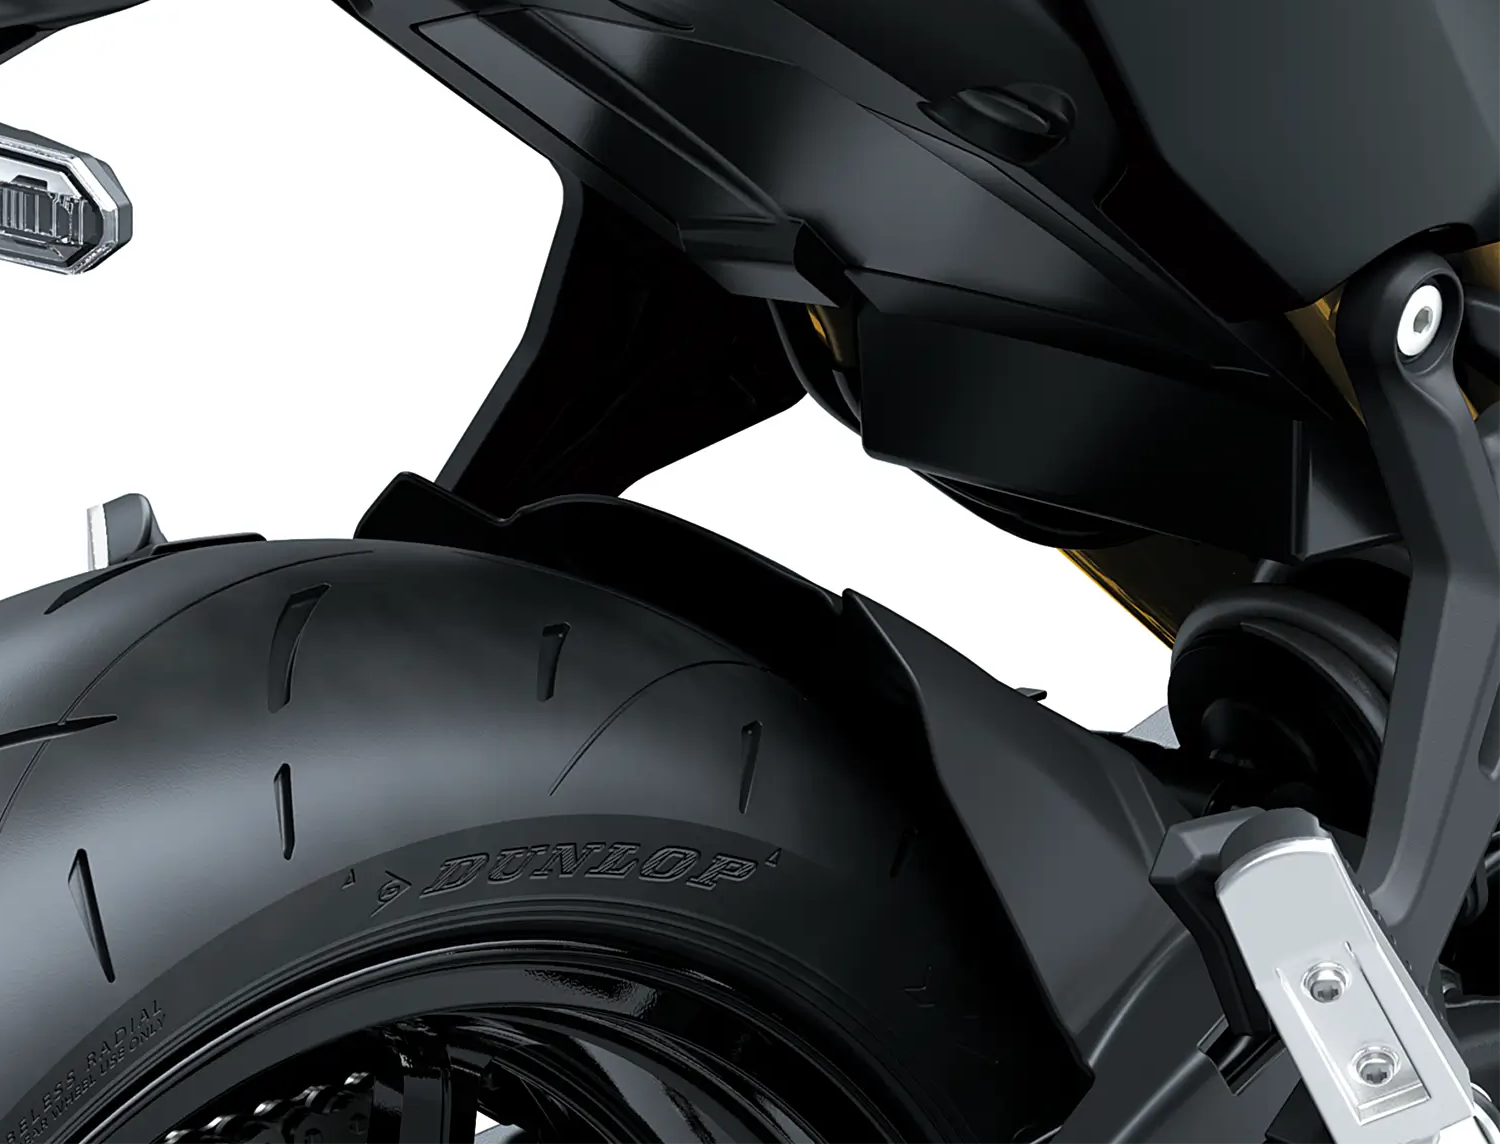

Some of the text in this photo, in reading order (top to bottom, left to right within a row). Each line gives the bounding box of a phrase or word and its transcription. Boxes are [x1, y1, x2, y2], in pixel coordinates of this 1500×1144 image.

[419, 841, 759, 899] DUNLOP
[51, 1074, 97, 1121] WHEEL
[99, 1046, 126, 1077] USE
[129, 1012, 167, 1054] ONLY
[86, 999, 163, 1072] RADIAL
